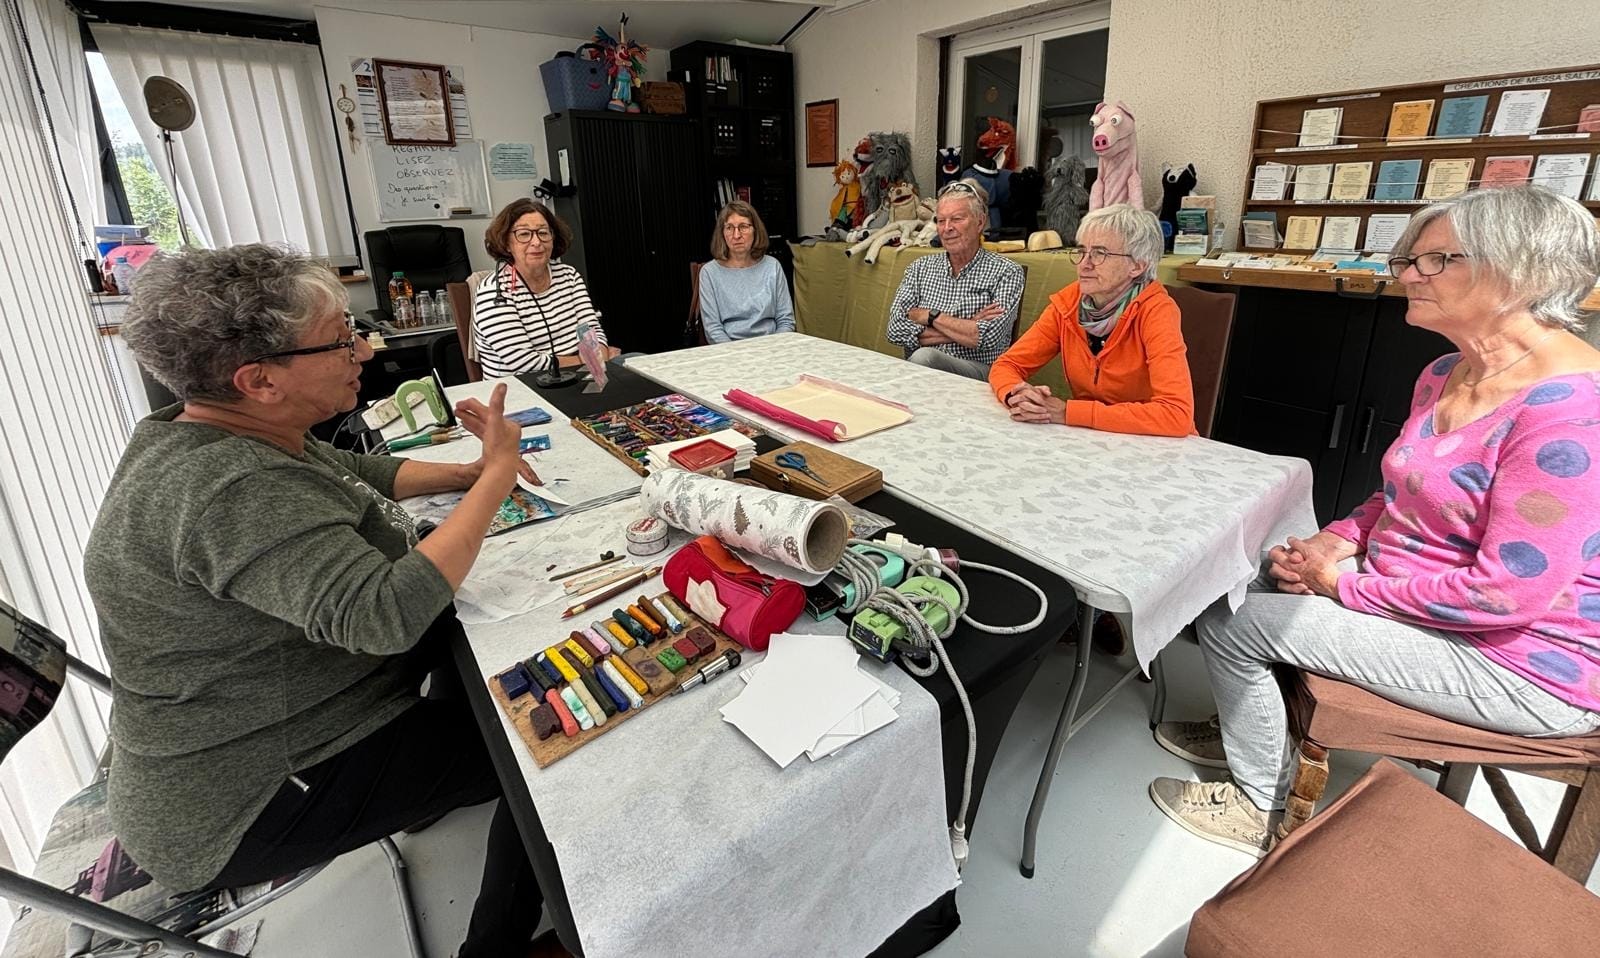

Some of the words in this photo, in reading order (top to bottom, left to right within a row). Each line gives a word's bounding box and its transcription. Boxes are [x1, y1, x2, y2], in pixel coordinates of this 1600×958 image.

[1510, 78, 1522, 86] DE
[396, 155, 435, 166] LISEZ
[396, 168, 455, 179] OBSERVEZ
